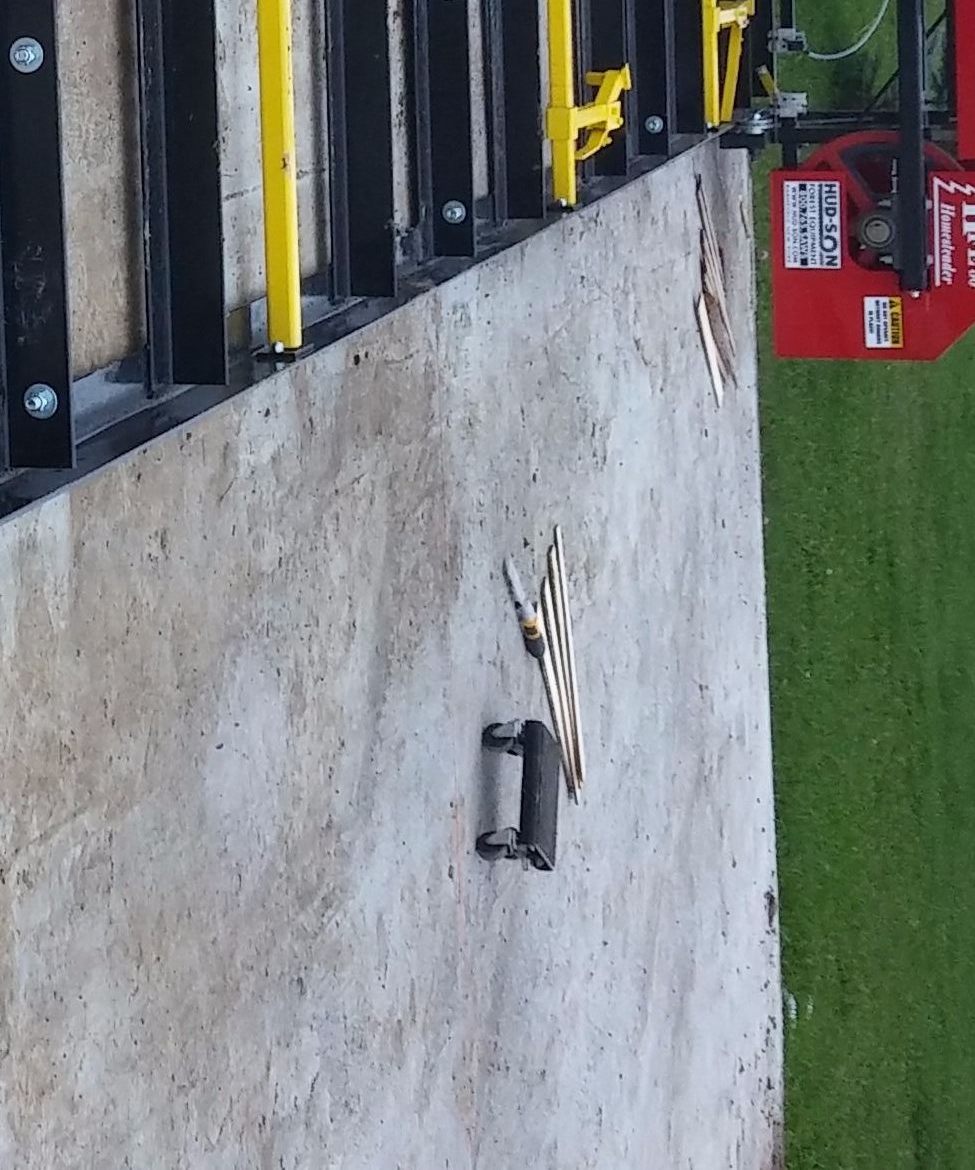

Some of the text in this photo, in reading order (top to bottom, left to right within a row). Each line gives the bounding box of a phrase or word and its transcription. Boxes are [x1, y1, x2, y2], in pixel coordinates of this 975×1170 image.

[808, 183, 817, 265] FOREST EQUIPMENT
[823, 183, 838, 267] HUD-SON
[940, 202, 957, 285] Homesteader
[891, 312, 900, 344] CAUTION
